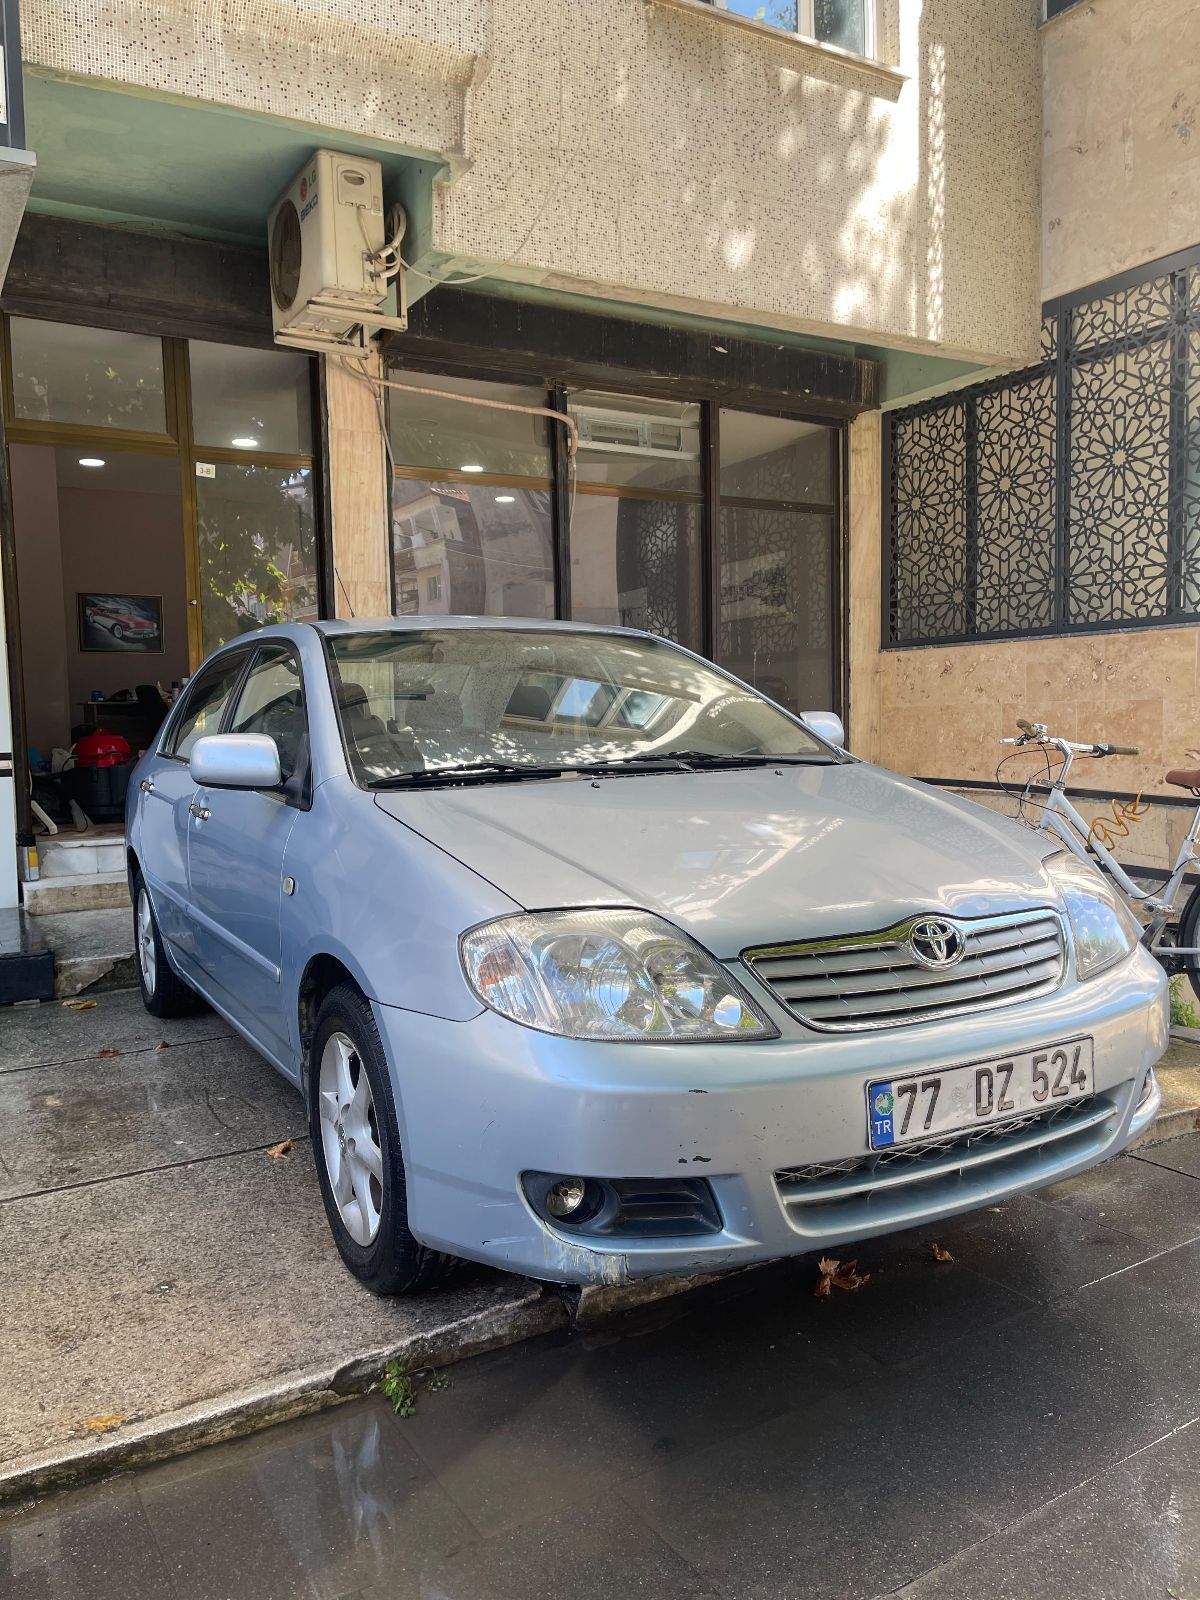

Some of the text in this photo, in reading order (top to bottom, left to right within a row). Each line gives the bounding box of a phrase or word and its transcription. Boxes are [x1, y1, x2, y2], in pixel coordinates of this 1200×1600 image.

[308, 169, 317, 188] LG
[300, 193, 319, 222] BEKO
[897, 1045, 1087, 1135] 77 DZ 524
[874, 1119, 892, 1135] TR
